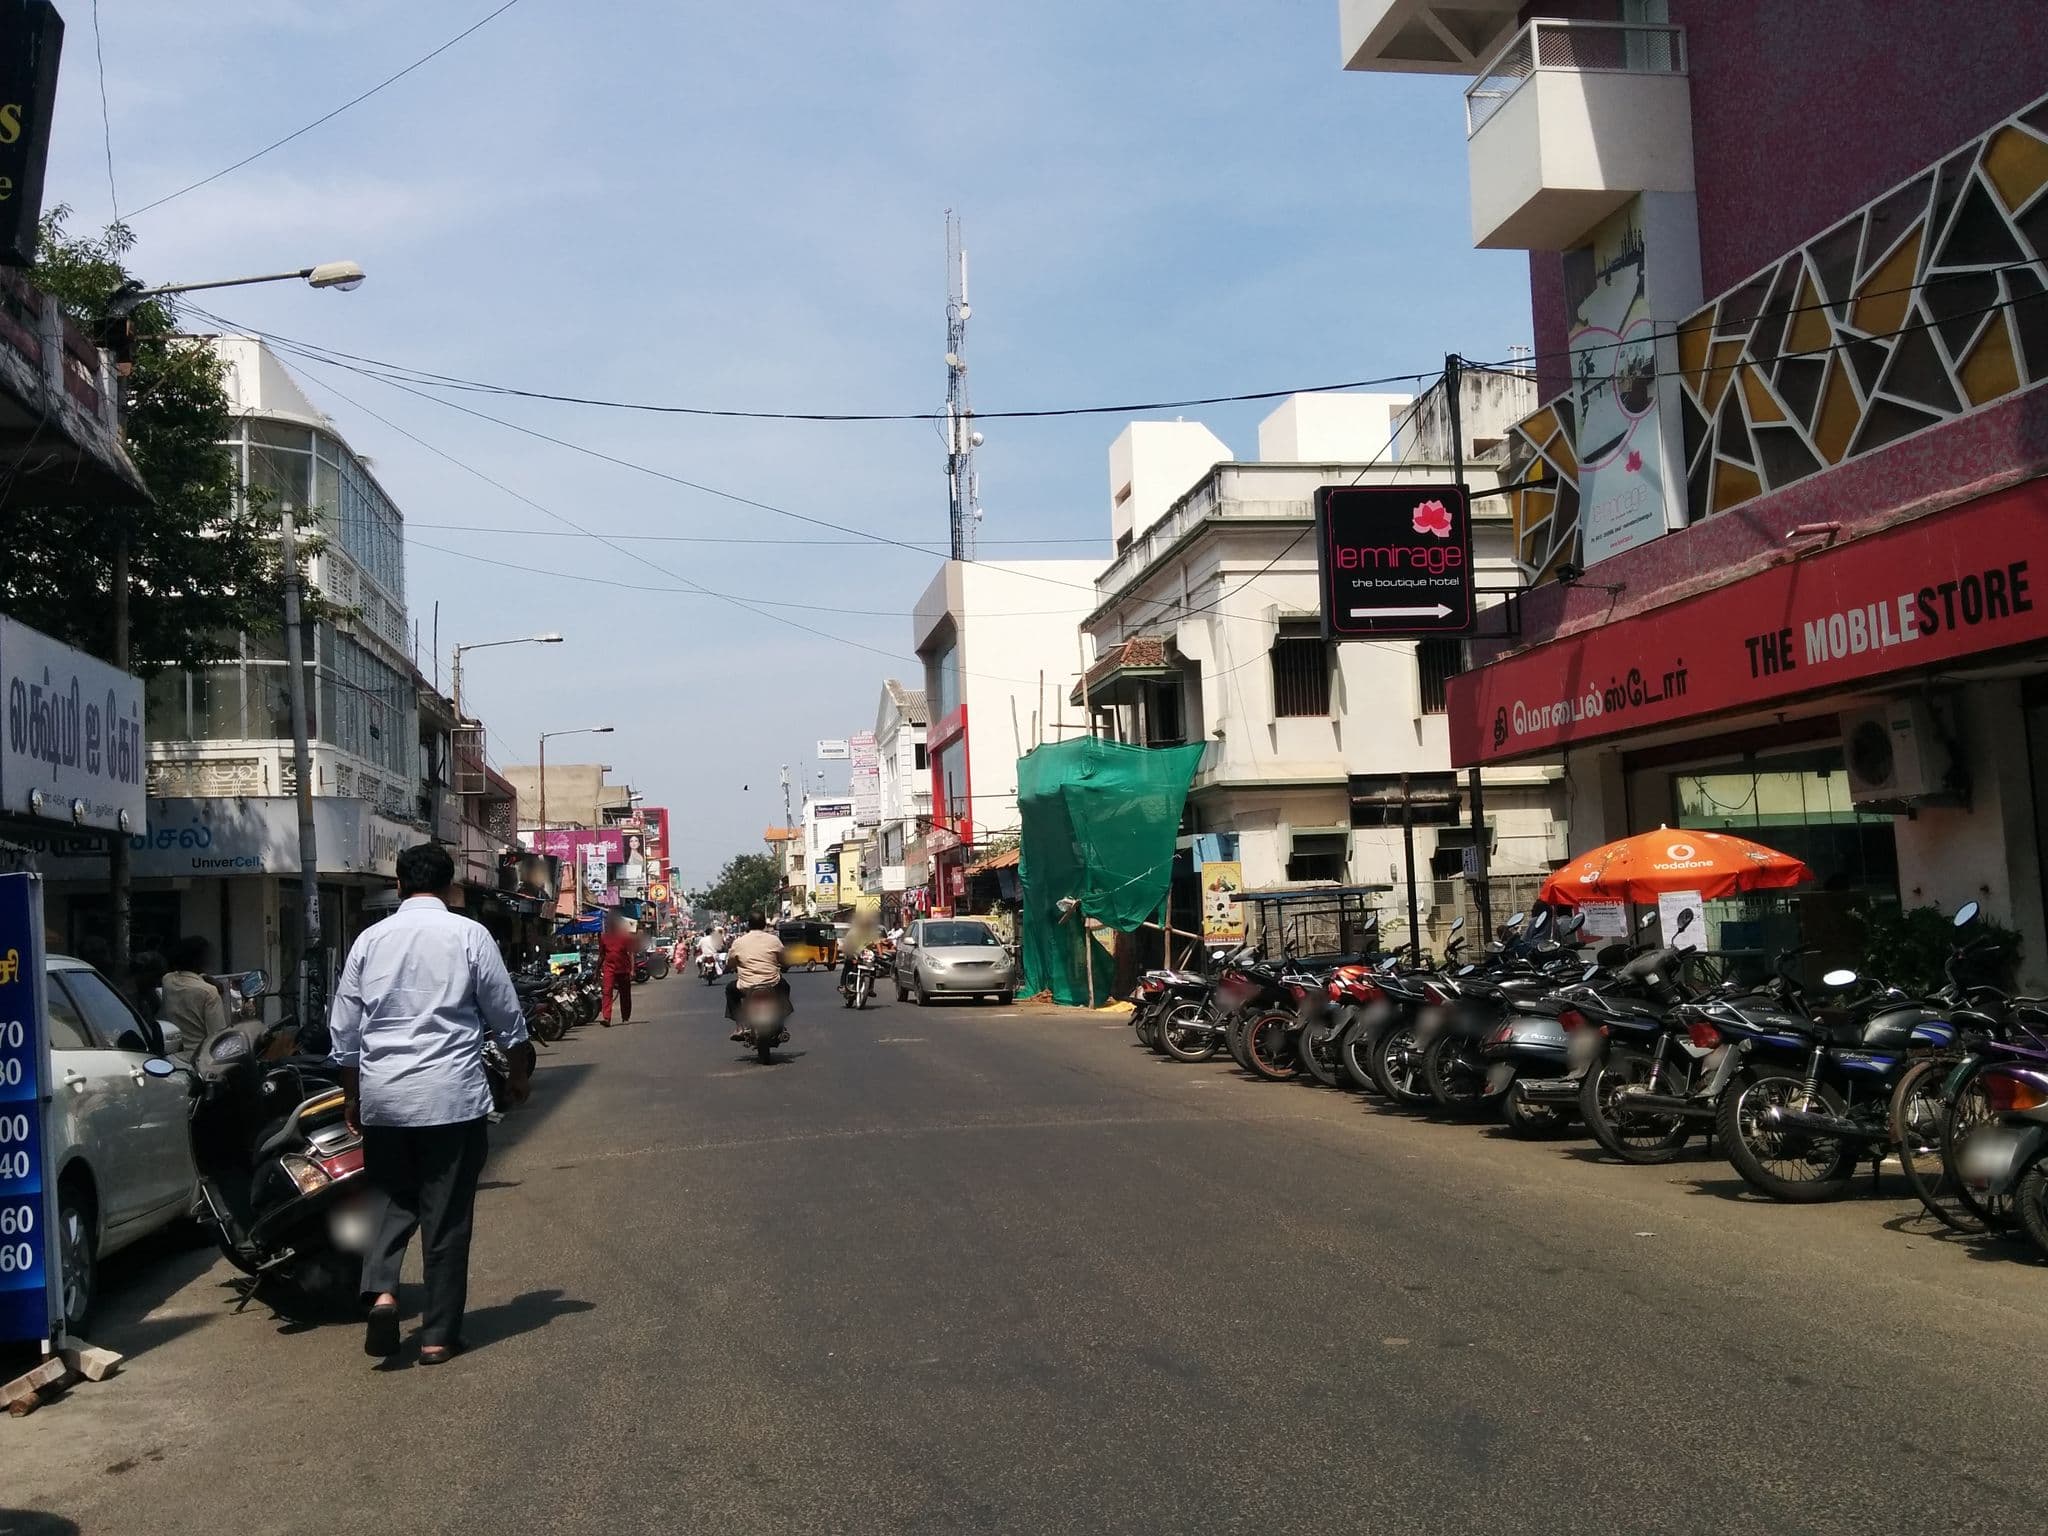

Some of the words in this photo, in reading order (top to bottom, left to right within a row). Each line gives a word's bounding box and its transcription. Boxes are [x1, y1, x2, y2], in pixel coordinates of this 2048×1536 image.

[1352, 579, 1373, 588] the
[1375, 578, 1427, 588] boutique
[1429, 577, 1460, 587] hotel
[1745, 627, 1796, 678] THE
[1804, 560, 2033, 665] MOBILESTORE
[192, 856, 260, 869] UniverCell
[1653, 860, 1714, 870] vodafone
[0, 1205, 34, 1236] 60
[0, 1242, 33, 1273] 60
